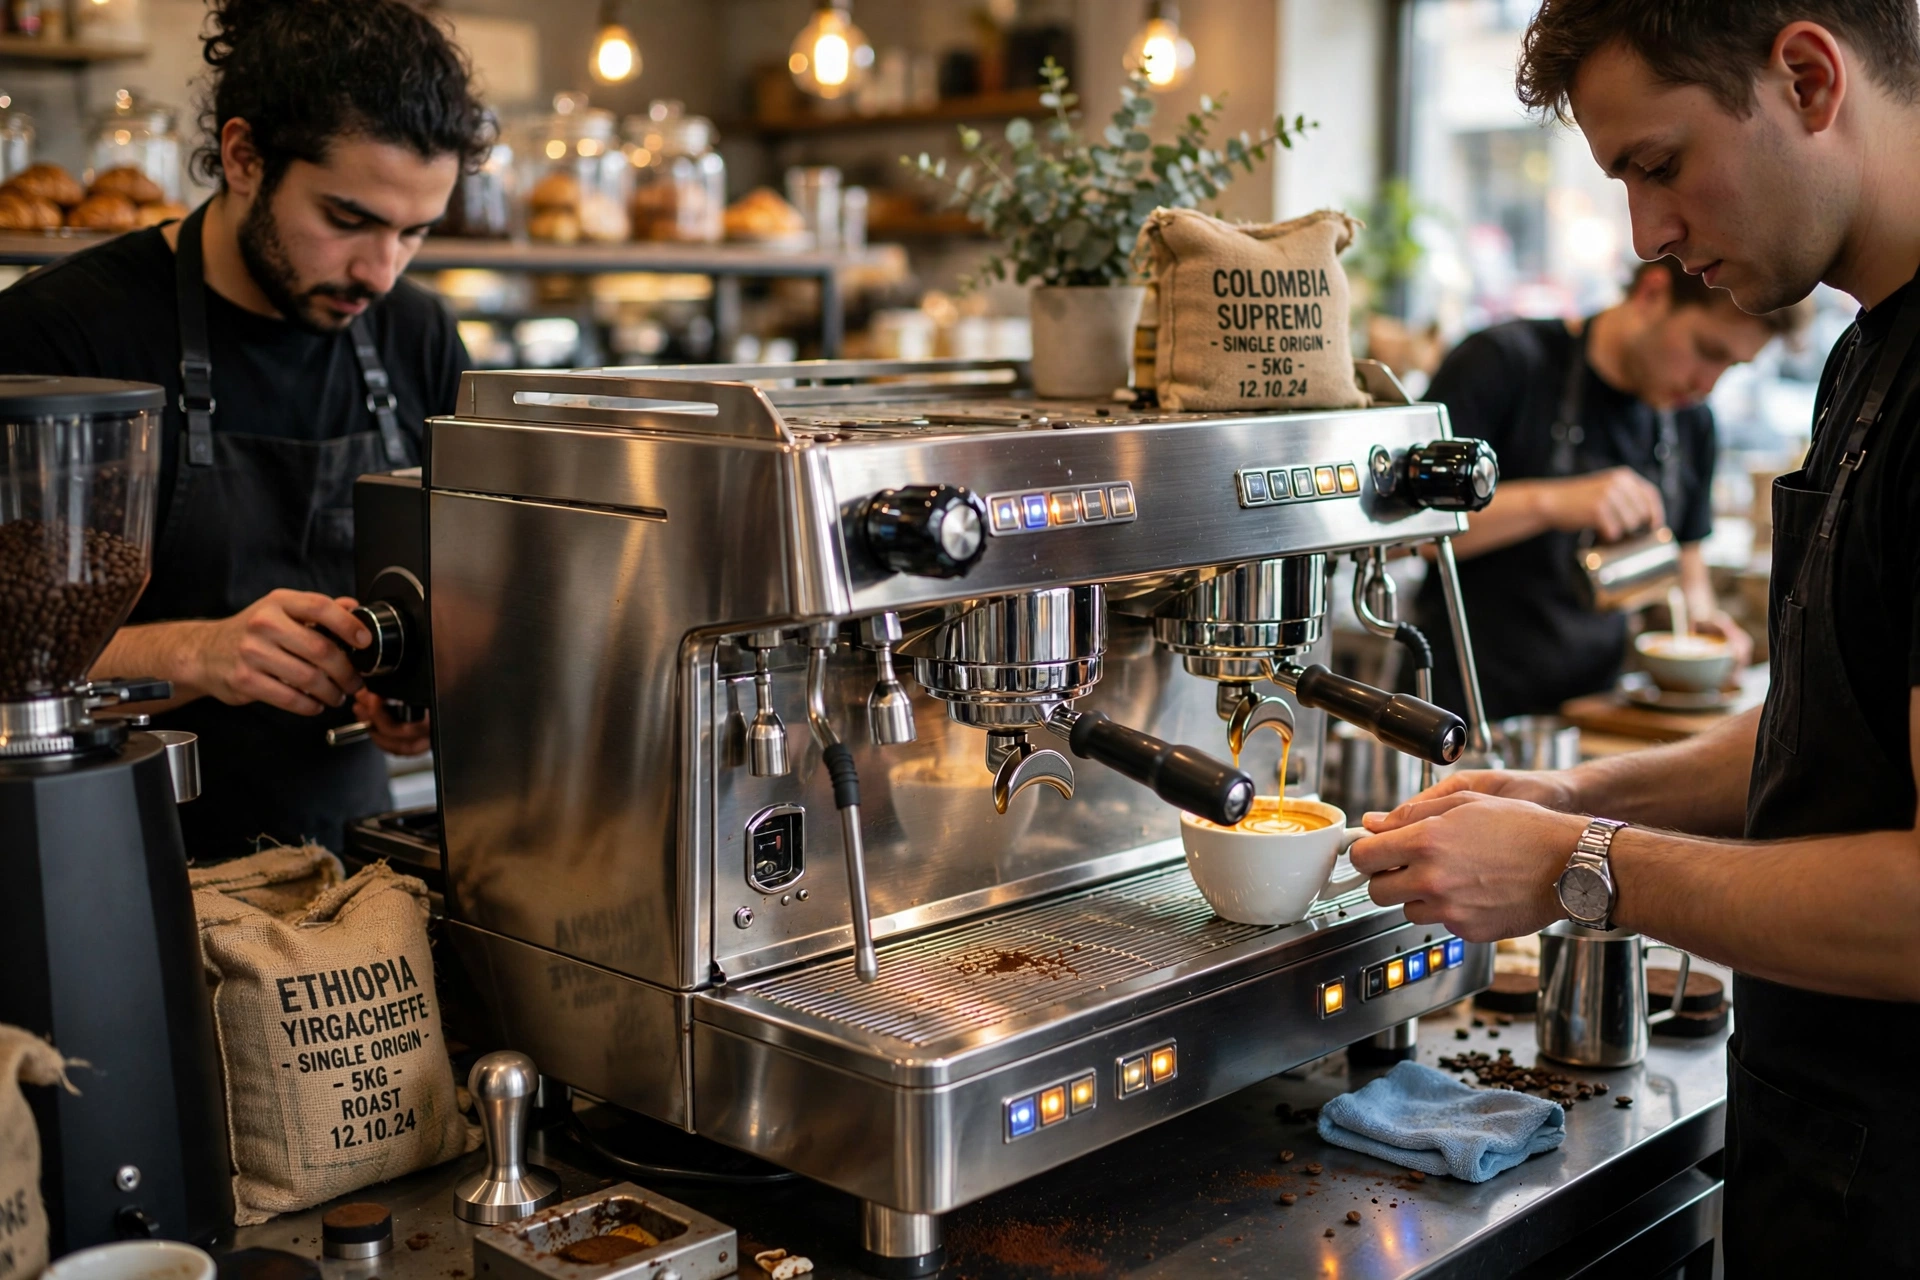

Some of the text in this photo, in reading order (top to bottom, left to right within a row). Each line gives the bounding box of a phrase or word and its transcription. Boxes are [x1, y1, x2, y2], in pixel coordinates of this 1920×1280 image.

[1213, 269, 1331, 298] COLOMBIA
[1217, 303, 1322, 330] SUPREMO
[1223, 336, 1275, 353] SINGLE
[1279, 334, 1324, 352] ORIGIN
[1262, 357, 1293, 376] 5KG
[1238, 379, 1308, 398] 12.10.24
[276, 955, 418, 1014] ETHIOPIA
[280, 993, 429, 1048] YIRGACHEFFE
[297, 1044, 367, 1074] SINGLE
[370, 1029, 422, 1061] ORIGIN
[351, 1065, 388, 1093] 5KG
[341, 1087, 402, 1121] ROAST
[330, 1108, 417, 1150] 12.10.24
